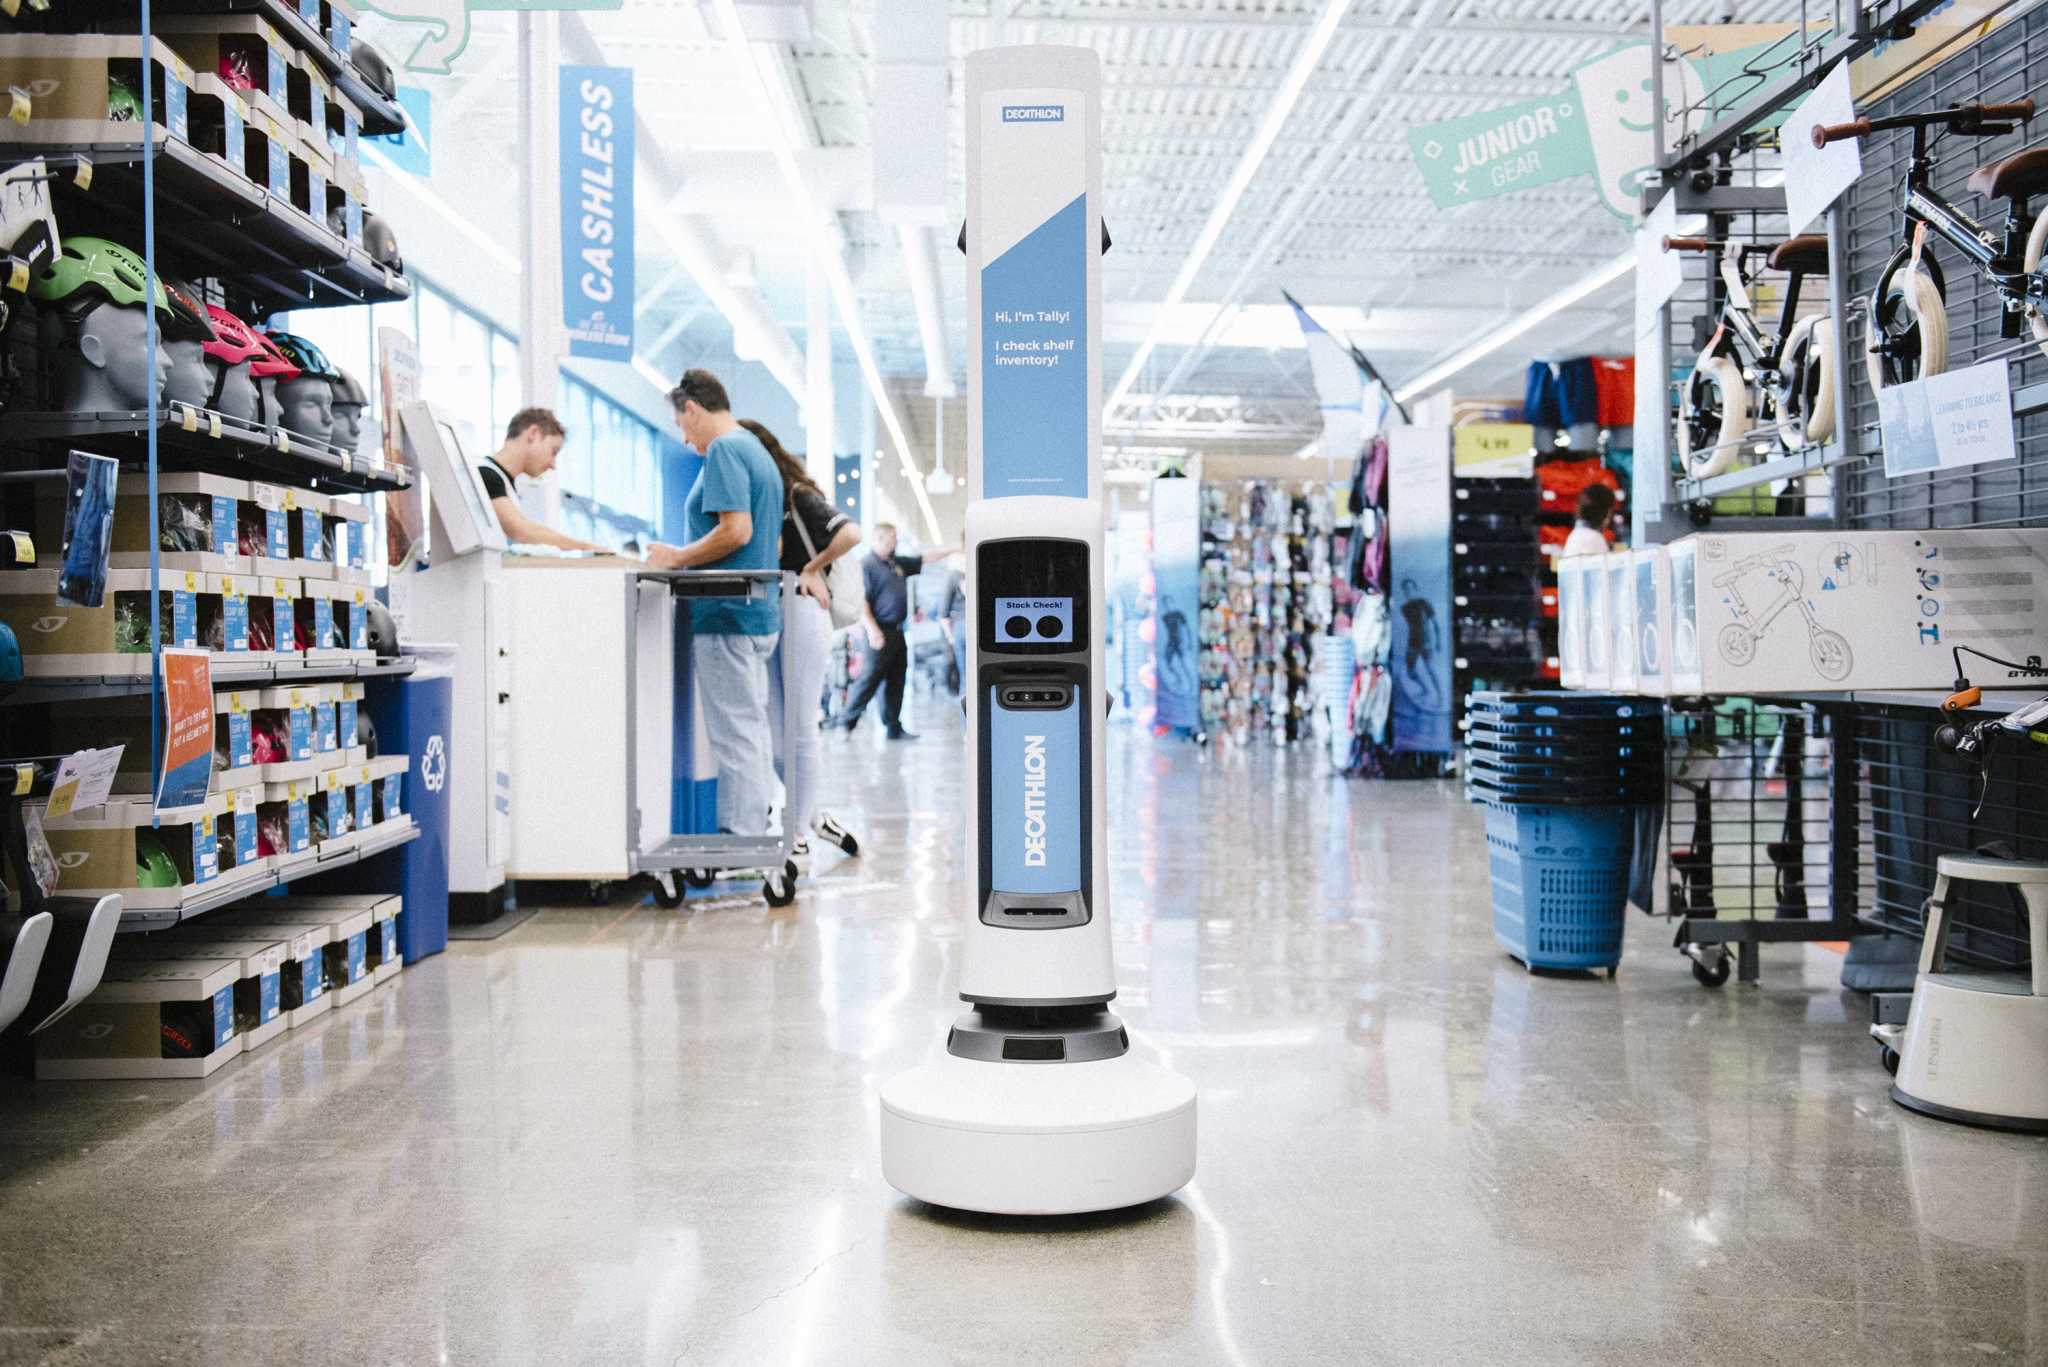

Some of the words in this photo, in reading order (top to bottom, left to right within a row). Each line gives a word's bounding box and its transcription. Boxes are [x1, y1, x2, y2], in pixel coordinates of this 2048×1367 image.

[1005, 108, 1062, 120] DECATHLON
[1454, 106, 1558, 173] JUNIOR
[1491, 151, 1541, 186] GEAR
[581, 79, 614, 303] CASHLESS
[995, 311, 1012, 324] Hi,
[1015, 311, 1035, 322] I'm
[1037, 311, 1070, 324] Tally!
[995, 340, 1000, 351] I
[1002, 340, 1040, 351] check
[1043, 340, 1075, 351] shelf
[995, 354, 1059, 368] inventory!
[1006, 601, 1031, 609] Stock
[1033, 601, 1063, 609] Check!
[1024, 734, 1047, 867] DECATHLON
